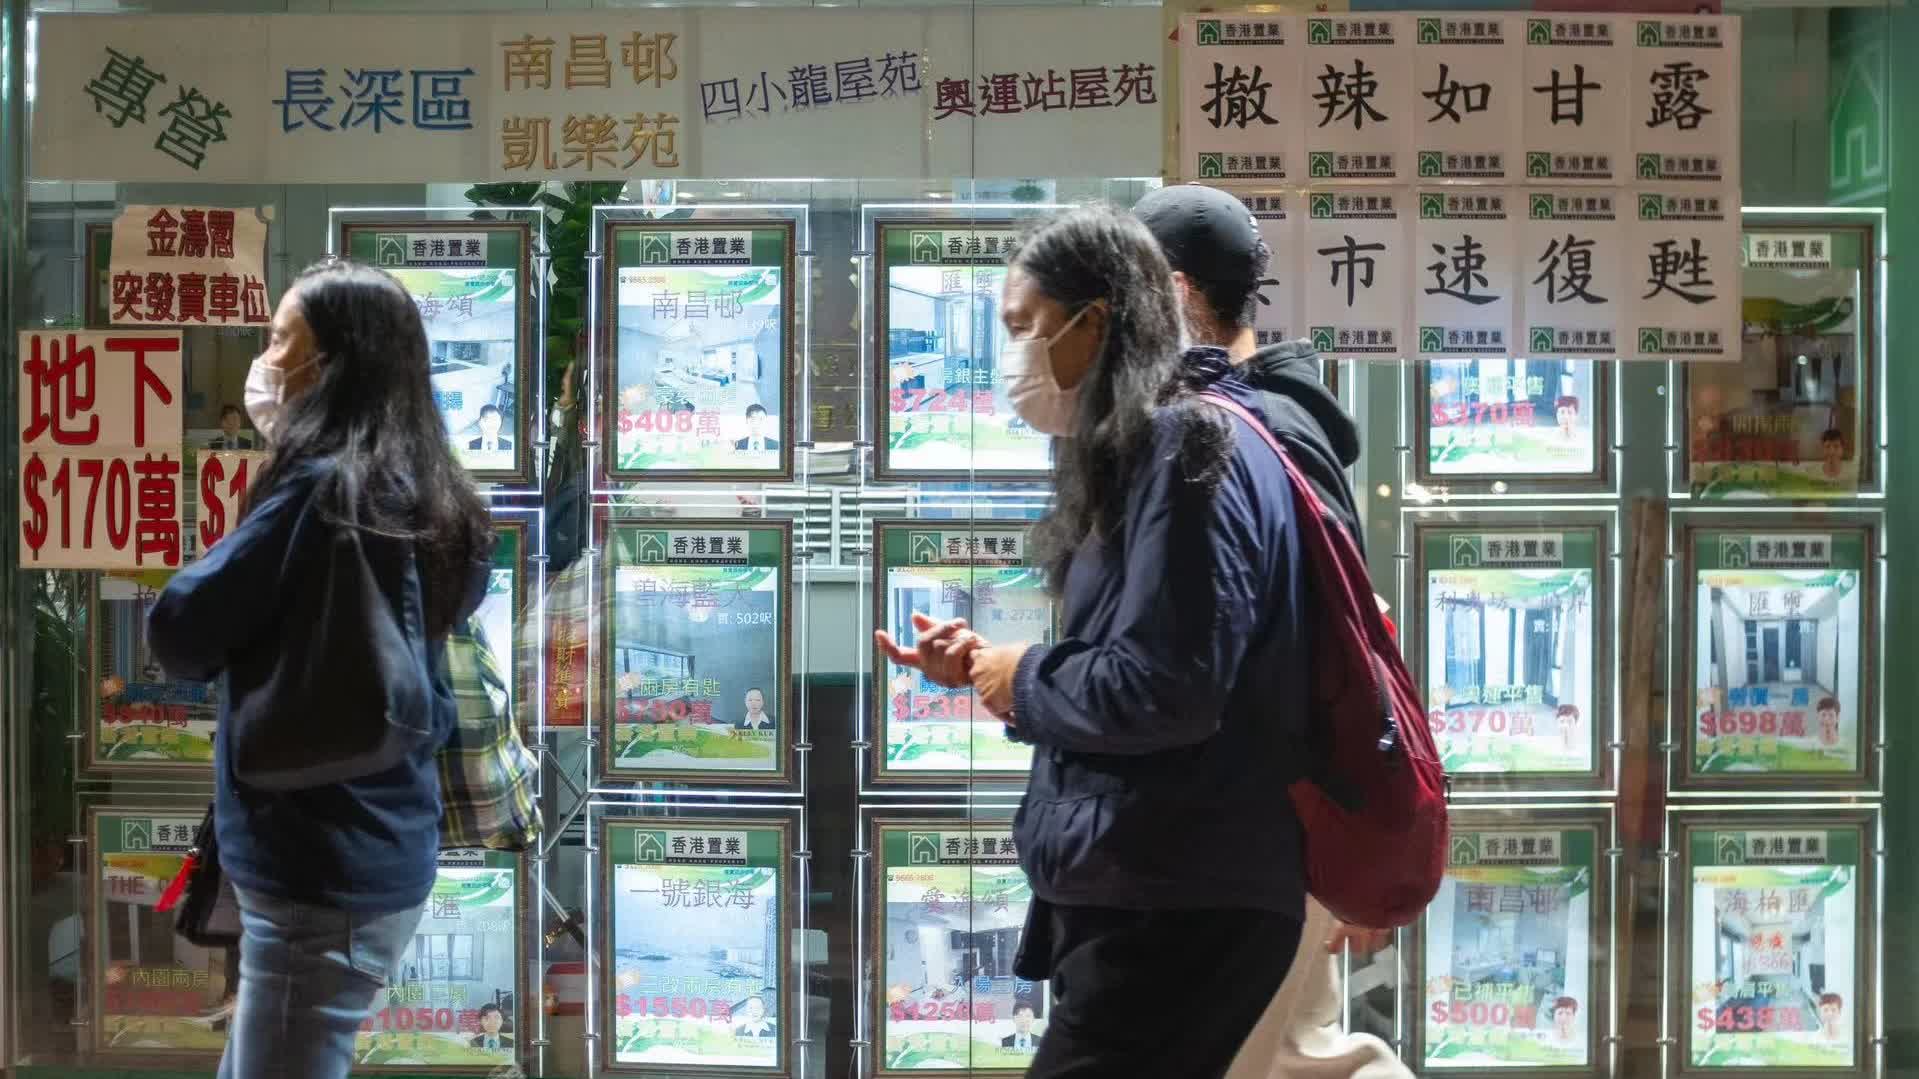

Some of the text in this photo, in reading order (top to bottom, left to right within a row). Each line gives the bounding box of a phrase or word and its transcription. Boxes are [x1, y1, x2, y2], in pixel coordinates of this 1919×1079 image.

[500, 31, 679, 92] 南昌邨
[701, 50, 922, 120] 四小龍屋苑
[933, 62, 1157, 121] 奧運站屋苑
[1200, 58, 1713, 131] 撤辣如甘露
[82, 46, 233, 171] 專營
[272, 67, 474, 133] 長深區
[501, 112, 680, 172] 凱樂苑
[1242, 197, 1282, 211] 港置業
[147, 208, 235, 259] 金濤閣
[412, 239, 482, 257] 香港置業
[676, 237, 746, 255] 香港置業
[1756, 240, 1824, 258] 香港置業
[1256, 234, 1717, 307] 市速復甦
[113, 270, 270, 323] 突發賣車位
[652, 289, 744, 320] 南昌邨
[22, 334, 180, 448] 地下
[618, 408, 721, 438] $408萬
[22, 451, 180, 566] $170萬
[200, 451, 260, 550] $1
[673, 536, 744, 555] 香港置業
[946, 537, 1017, 555] 香港置業
[1487, 540, 1557, 558] 香港置業
[1757, 540, 1824, 558] 香港置業
[1429, 709, 1535, 736] $370萬
[1699, 711, 1807, 737] $698萬
[671, 836, 741, 855] 香港置業
[946, 837, 1015, 856] 香港置業
[1485, 838, 1554, 856] 香港置業
[1752, 837, 1821, 854] 香港置業
[107, 876, 145, 895] THE
[629, 878, 755, 910] 一號銀海
[424, 892, 462, 919] 匯
[616, 993, 733, 1024] $1550萬
[1431, 1000, 1537, 1029] $500萬
